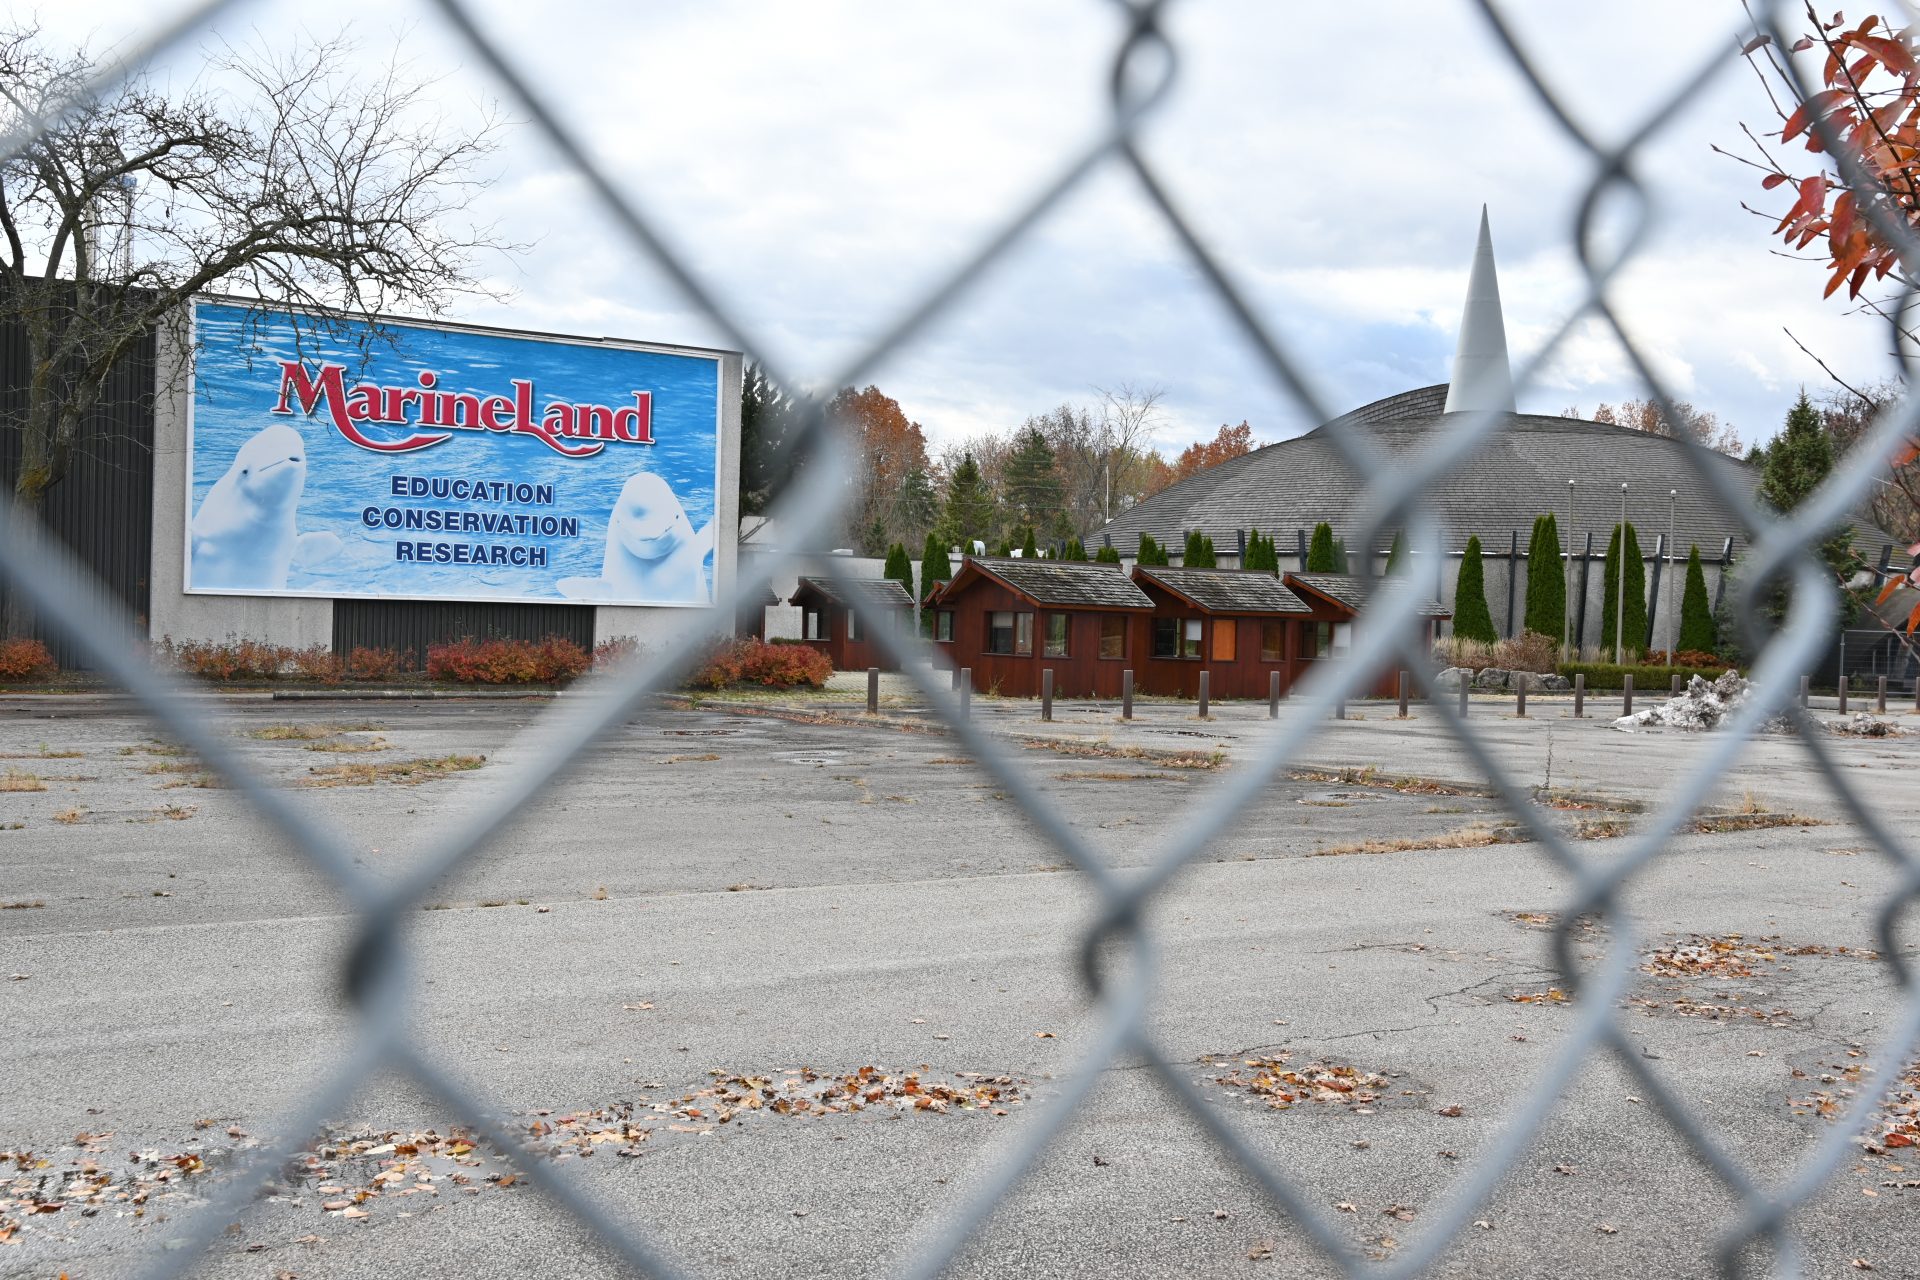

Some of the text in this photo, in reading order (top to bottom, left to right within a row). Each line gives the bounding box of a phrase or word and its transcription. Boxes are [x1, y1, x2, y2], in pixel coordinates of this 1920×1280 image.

[273, 360, 654, 457] MarineLand
[391, 475, 553, 504] EDUCATION
[361, 506, 578, 536] CONSERVATION
[396, 541, 547, 566] RESEARCH
